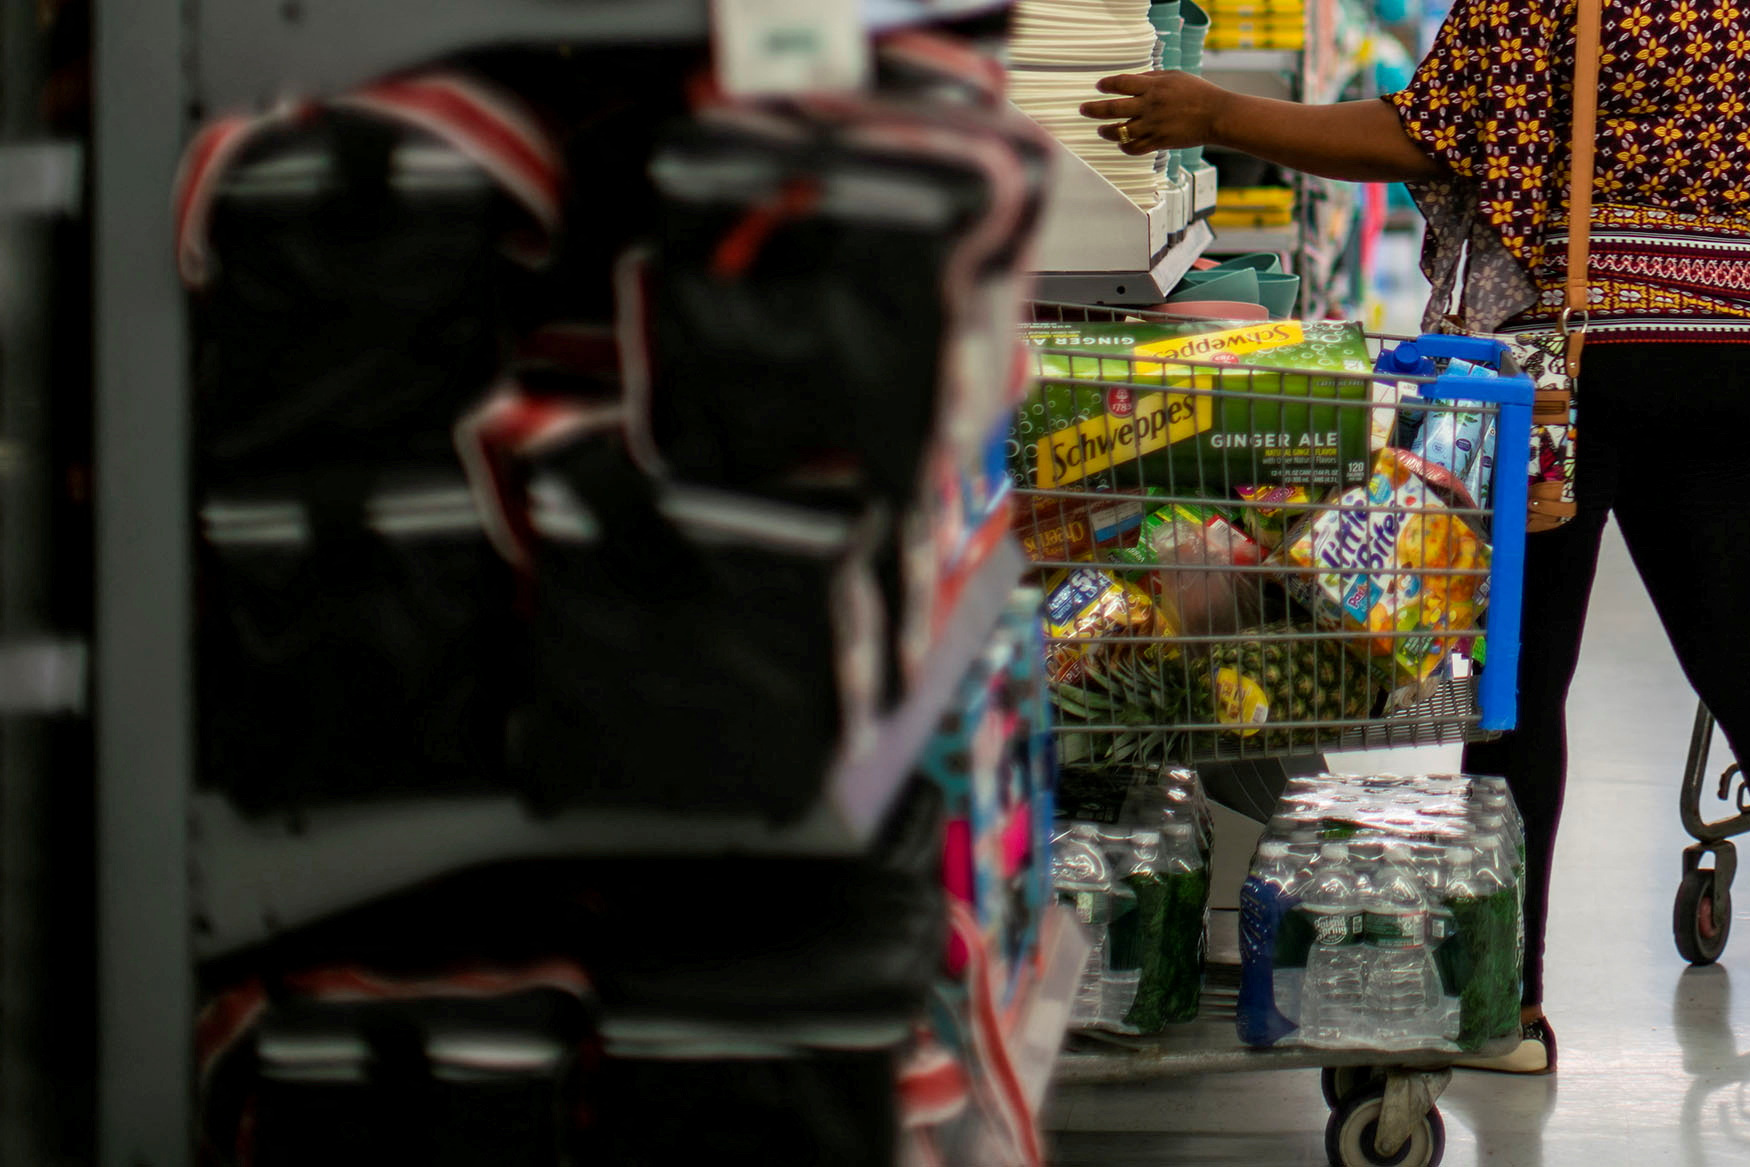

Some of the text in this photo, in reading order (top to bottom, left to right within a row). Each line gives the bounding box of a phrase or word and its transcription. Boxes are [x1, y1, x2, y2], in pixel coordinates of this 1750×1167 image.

[1055, 336, 1135, 345] GINGER
[1152, 324, 1292, 360] Schweppes
[1053, 394, 1194, 482] Schweppes
[1211, 433, 1338, 448] GINGER ALE
[1348, 462, 1364, 472] 120
